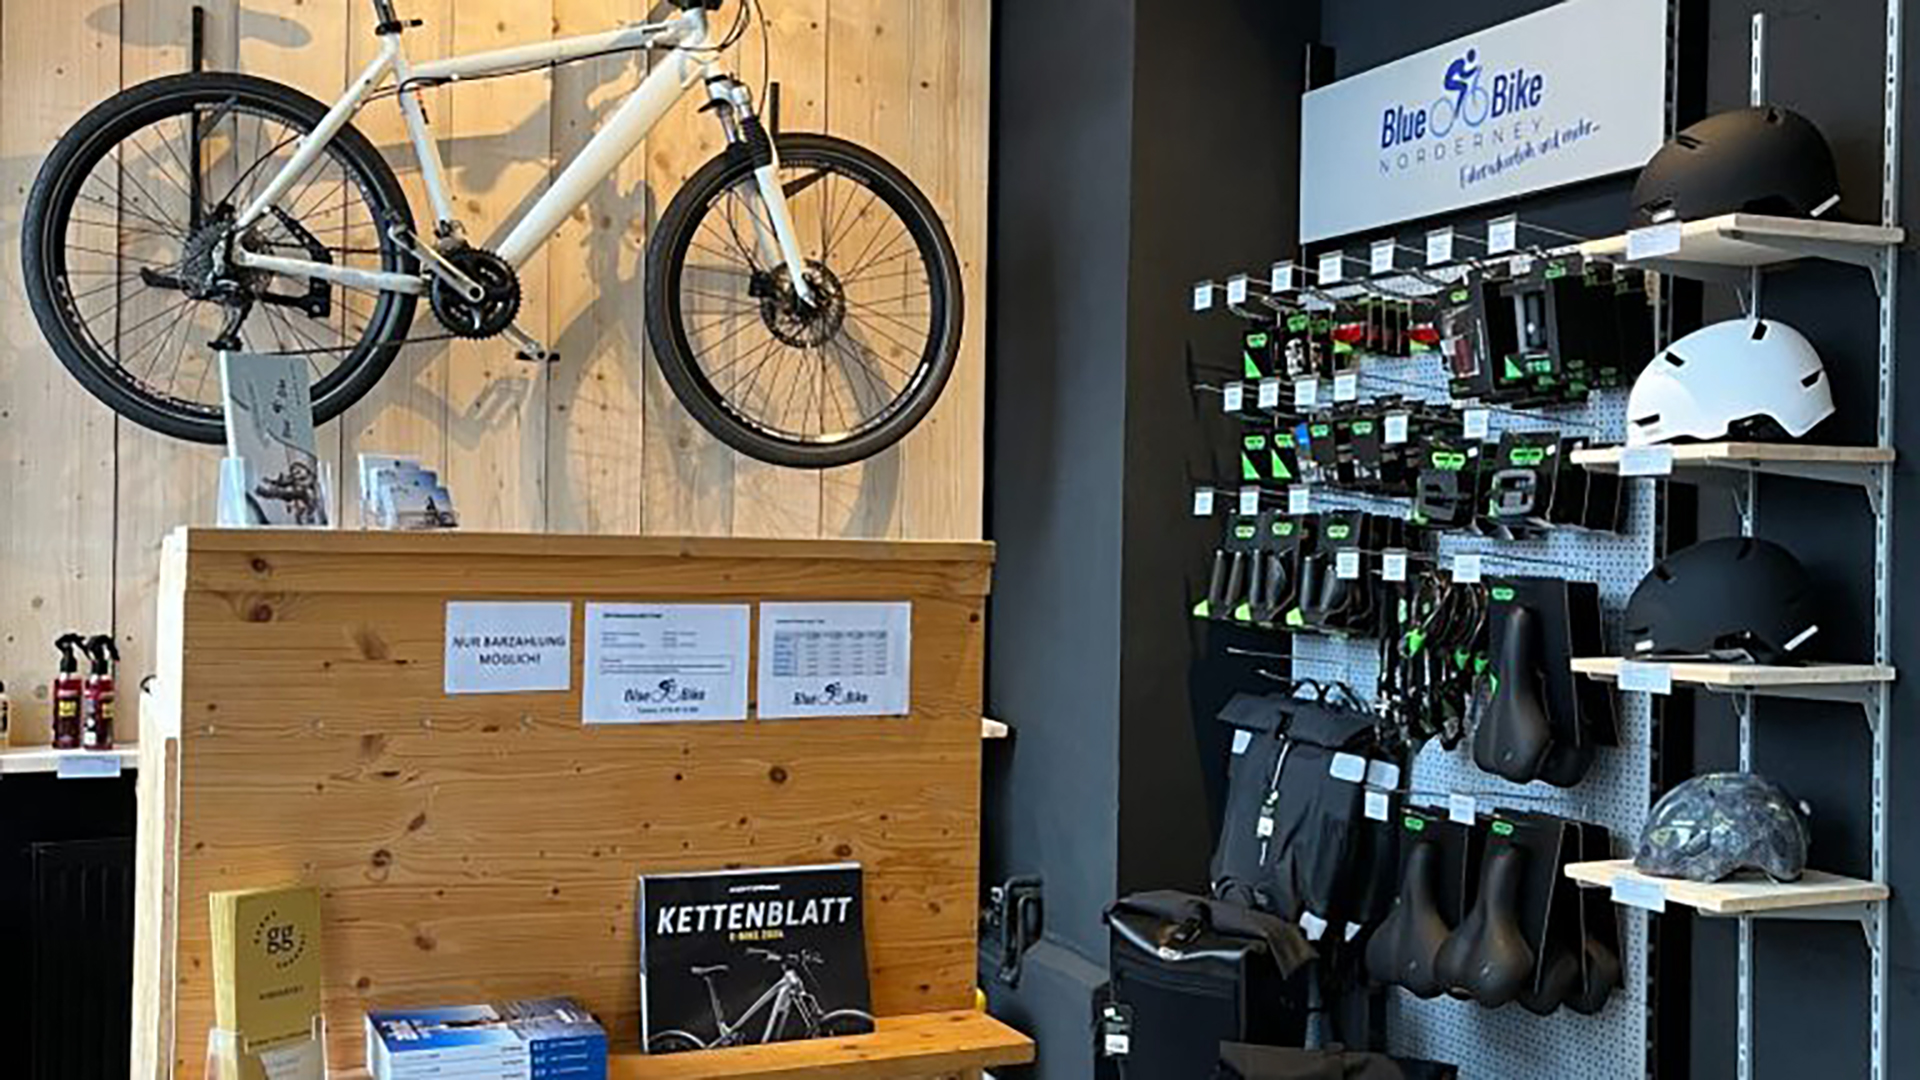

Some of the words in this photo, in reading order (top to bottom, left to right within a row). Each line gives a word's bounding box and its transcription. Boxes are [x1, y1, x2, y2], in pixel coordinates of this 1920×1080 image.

[1382, 104, 1427, 149] Blue
[1491, 68, 1543, 119] Bike
[1378, 117, 1543, 174] NORDERNEY
[453, 636, 481, 650] NUR
[483, 635, 567, 649] BARZAHLUNG
[656, 896, 853, 935] KETTENBLATT
[266, 924, 295, 955] gg
